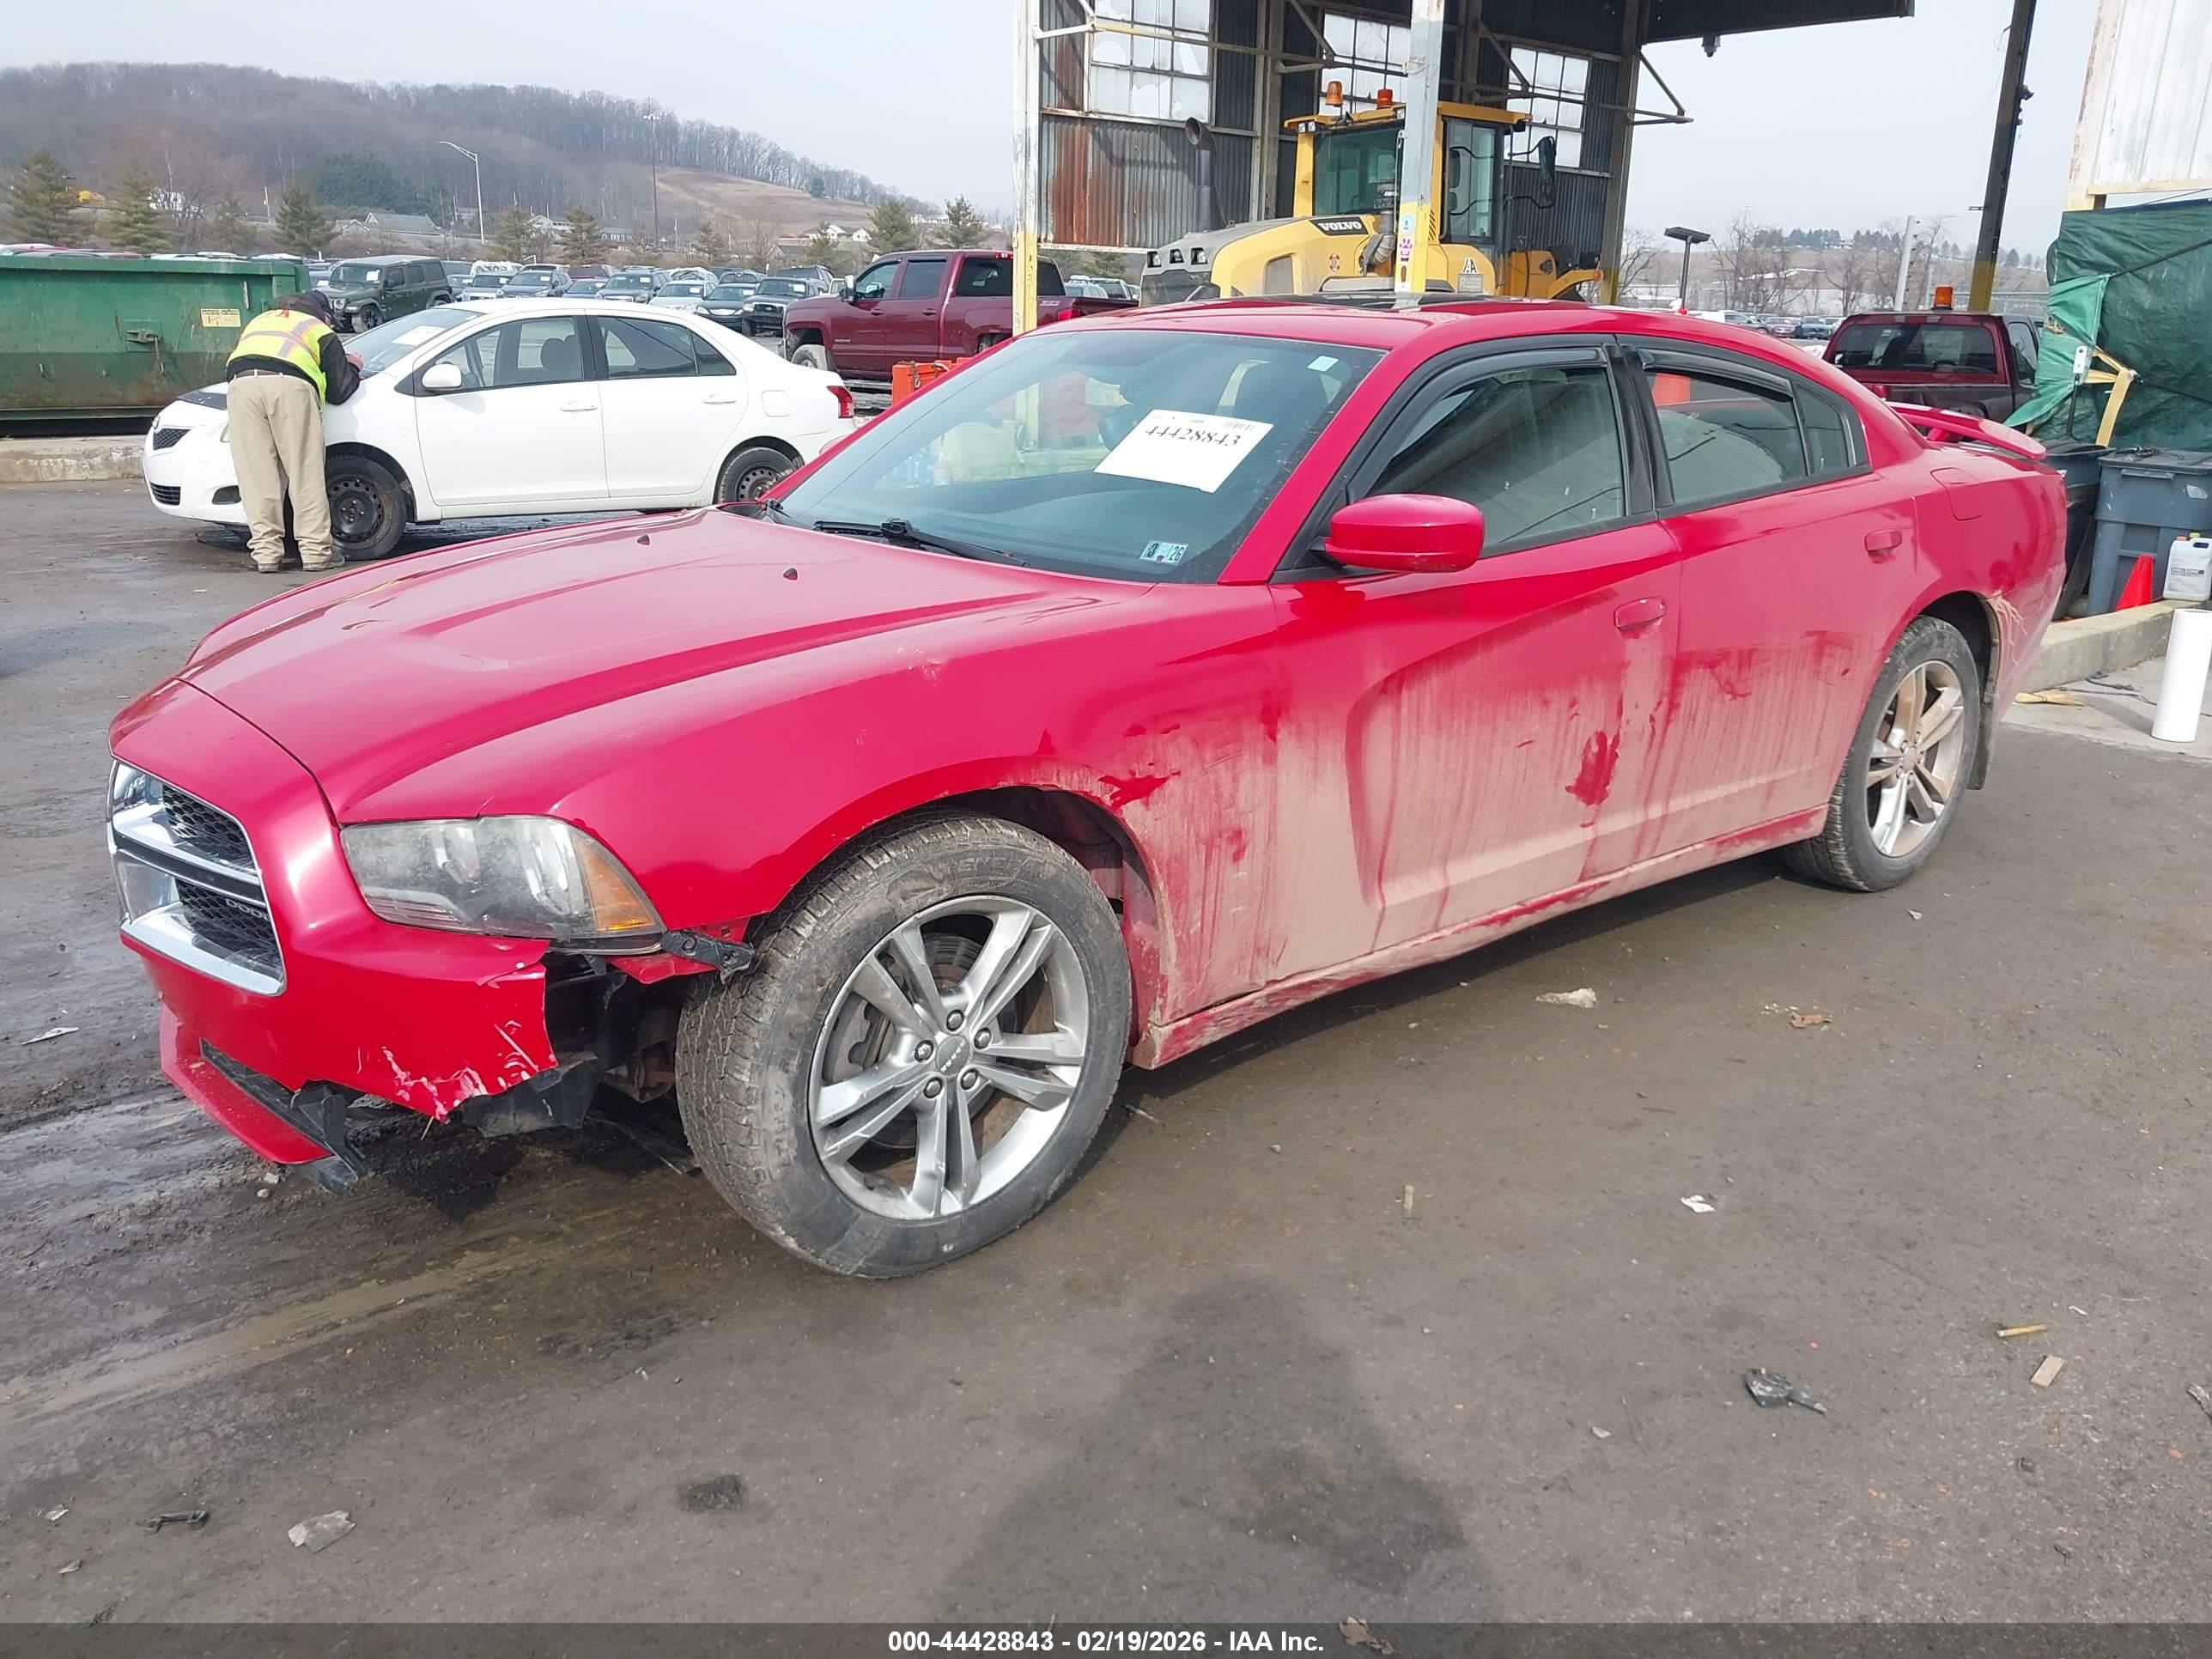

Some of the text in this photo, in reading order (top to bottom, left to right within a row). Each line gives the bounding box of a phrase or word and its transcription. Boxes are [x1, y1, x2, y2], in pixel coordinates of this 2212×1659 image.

[1318, 221, 1362, 231] VOLVO
[1145, 425, 1241, 447] 44428843
[1146, 543, 1184, 561] 3 26
